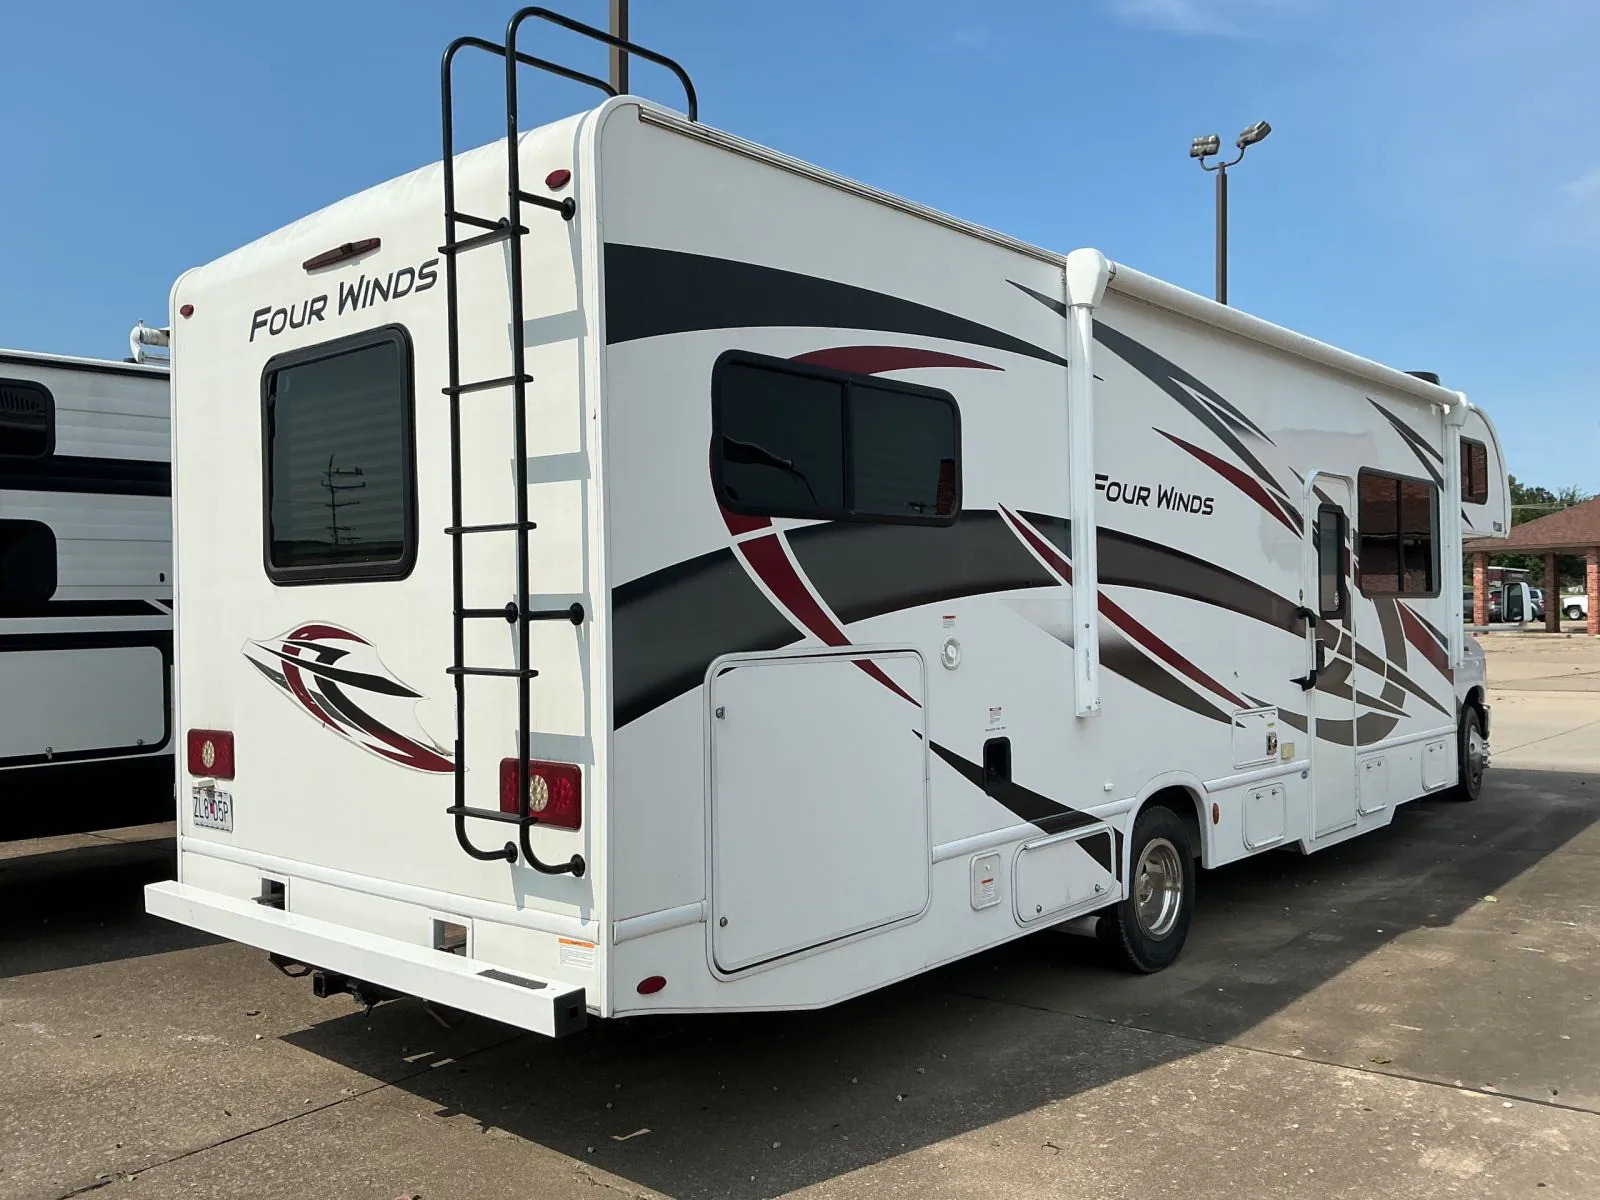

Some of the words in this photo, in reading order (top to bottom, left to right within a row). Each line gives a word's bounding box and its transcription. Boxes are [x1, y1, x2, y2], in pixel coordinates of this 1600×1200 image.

[249, 294, 328, 343] FOUR
[338, 257, 439, 316] WINDS
[1157, 484, 1215, 515] WINDS
